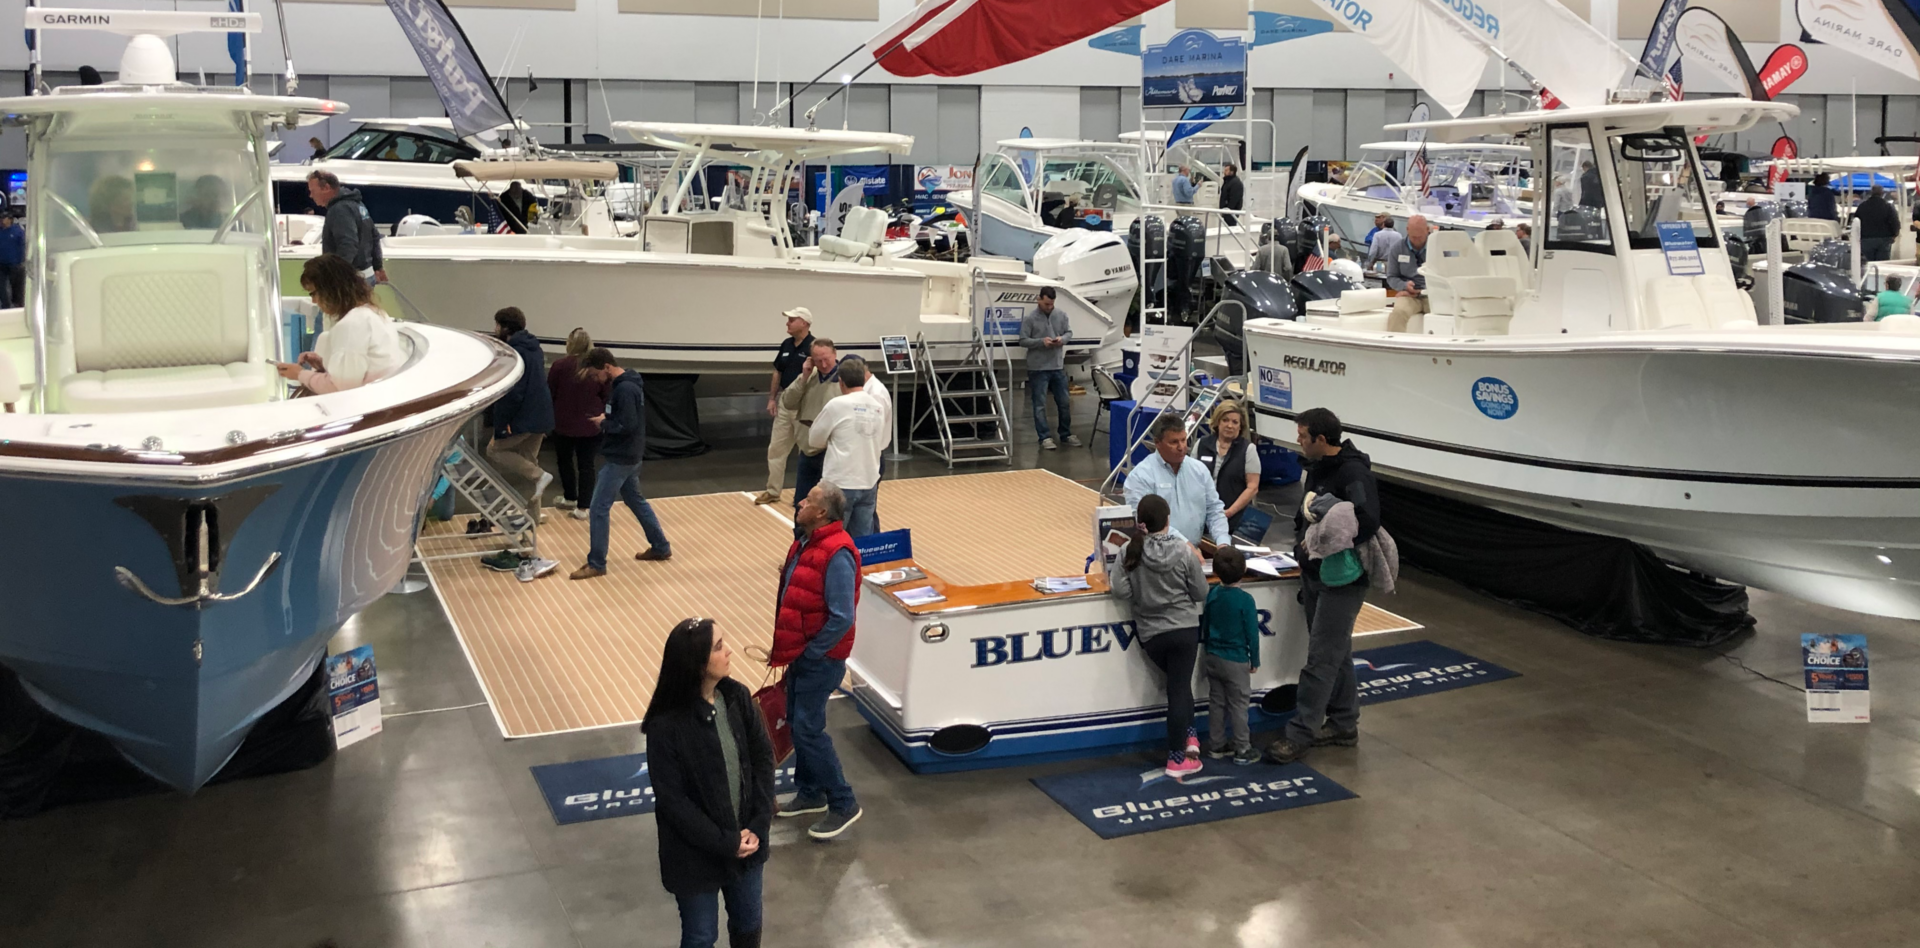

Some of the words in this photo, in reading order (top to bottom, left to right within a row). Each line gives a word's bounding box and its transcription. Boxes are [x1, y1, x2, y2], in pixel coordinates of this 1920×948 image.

[43, 14, 110, 25] GARMIN
[1162, 54, 1185, 65] DARE
[1189, 52, 1223, 62] MARINA
[949, 166, 973, 180] JON
[1283, 354, 1347, 376] REGULATOR
[1260, 368, 1273, 383] NO
[1478, 382, 1510, 395] BONUS
[1475, 390, 1515, 405] SAVINGS
[970, 608, 1276, 669] BLUEWR
[1807, 656, 1841, 665] CHOICE
[330, 673, 356, 690] CHOICE
[1356, 661, 1479, 690] uewater
[1357, 683, 1411, 698] ACHT
[1422, 670, 1488, 685] SALES
[1092, 776, 1314, 819] Bluewater
[1118, 804, 1213, 825] YACHT
[1229, 787, 1319, 807] SALES
